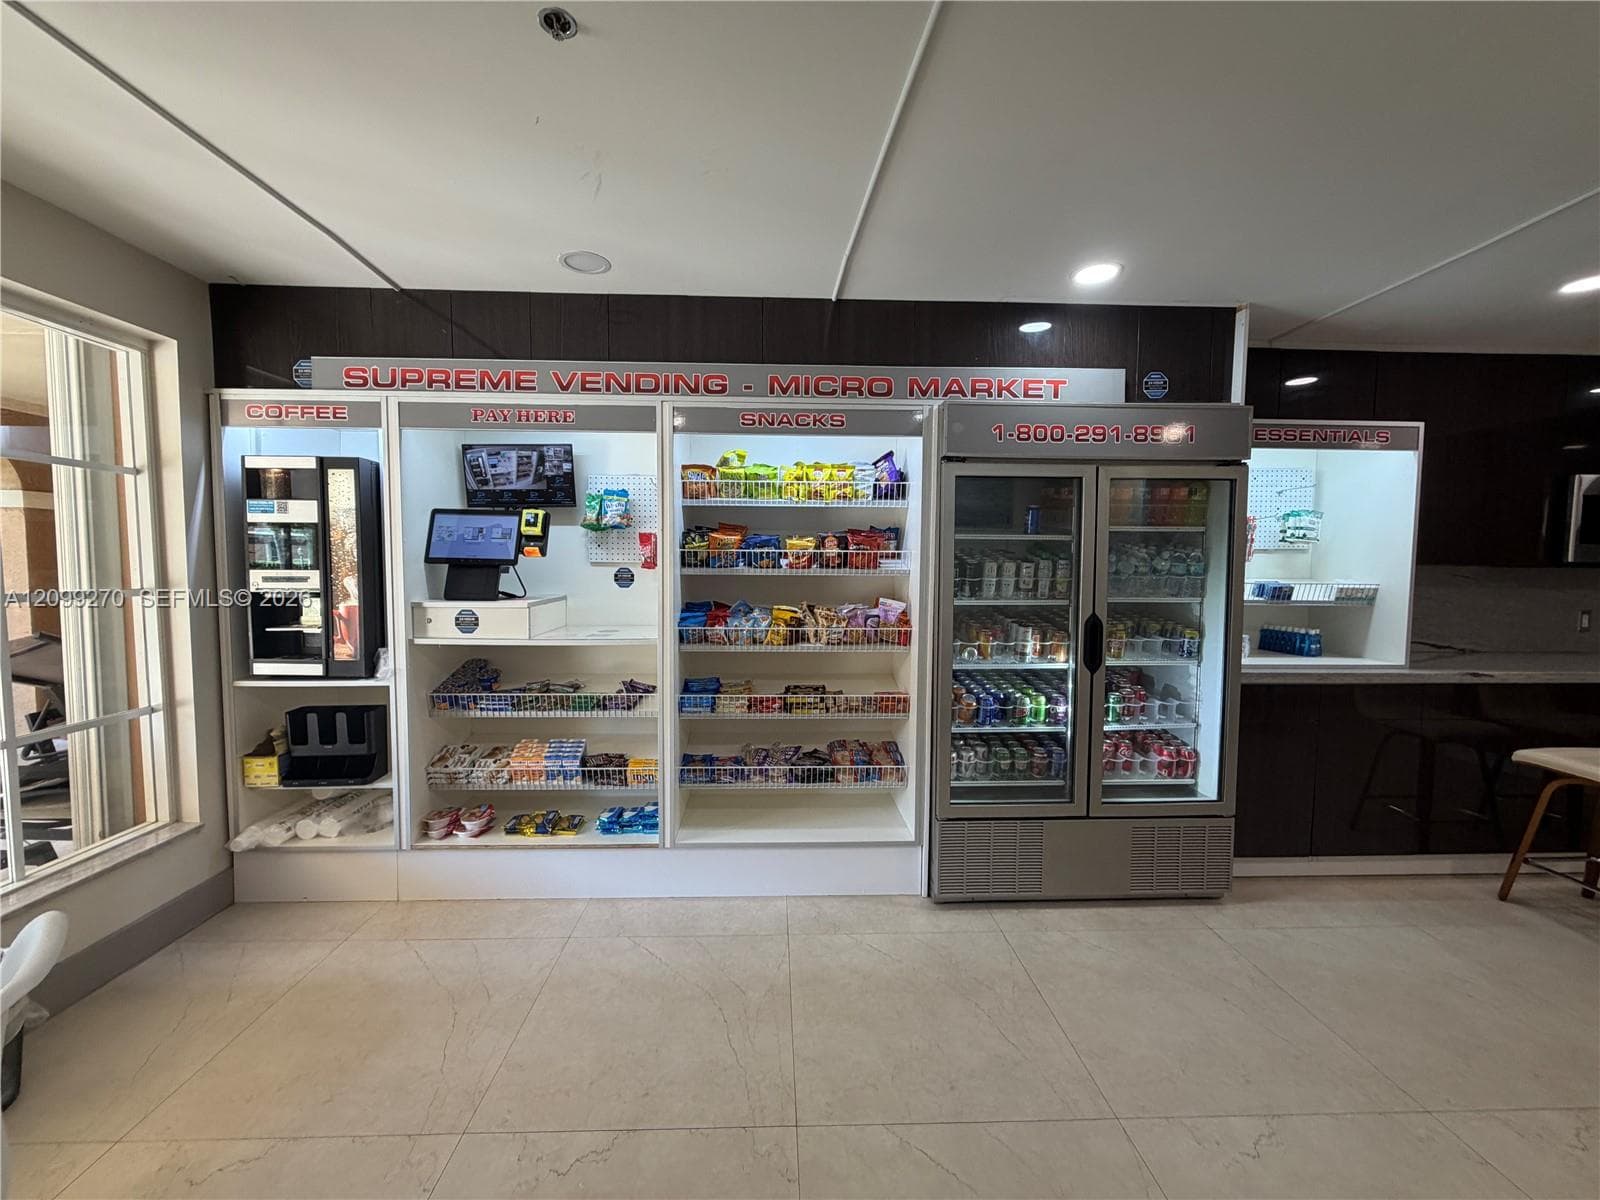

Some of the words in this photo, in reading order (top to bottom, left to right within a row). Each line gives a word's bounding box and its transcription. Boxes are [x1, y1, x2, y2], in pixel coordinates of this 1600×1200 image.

[343, 366, 538, 392] SUPREME
[550, 370, 729, 395] VENDING
[768, 374, 895, 398] MICRO
[907, 376, 1069, 400] MARKET
[245, 404, 349, 421] COFFEE
[470, 408, 513, 423] PAY
[516, 409, 576, 424] HERE
[739, 411, 847, 430] SNACKS
[1253, 428, 1391, 444] ESSENTIALS
